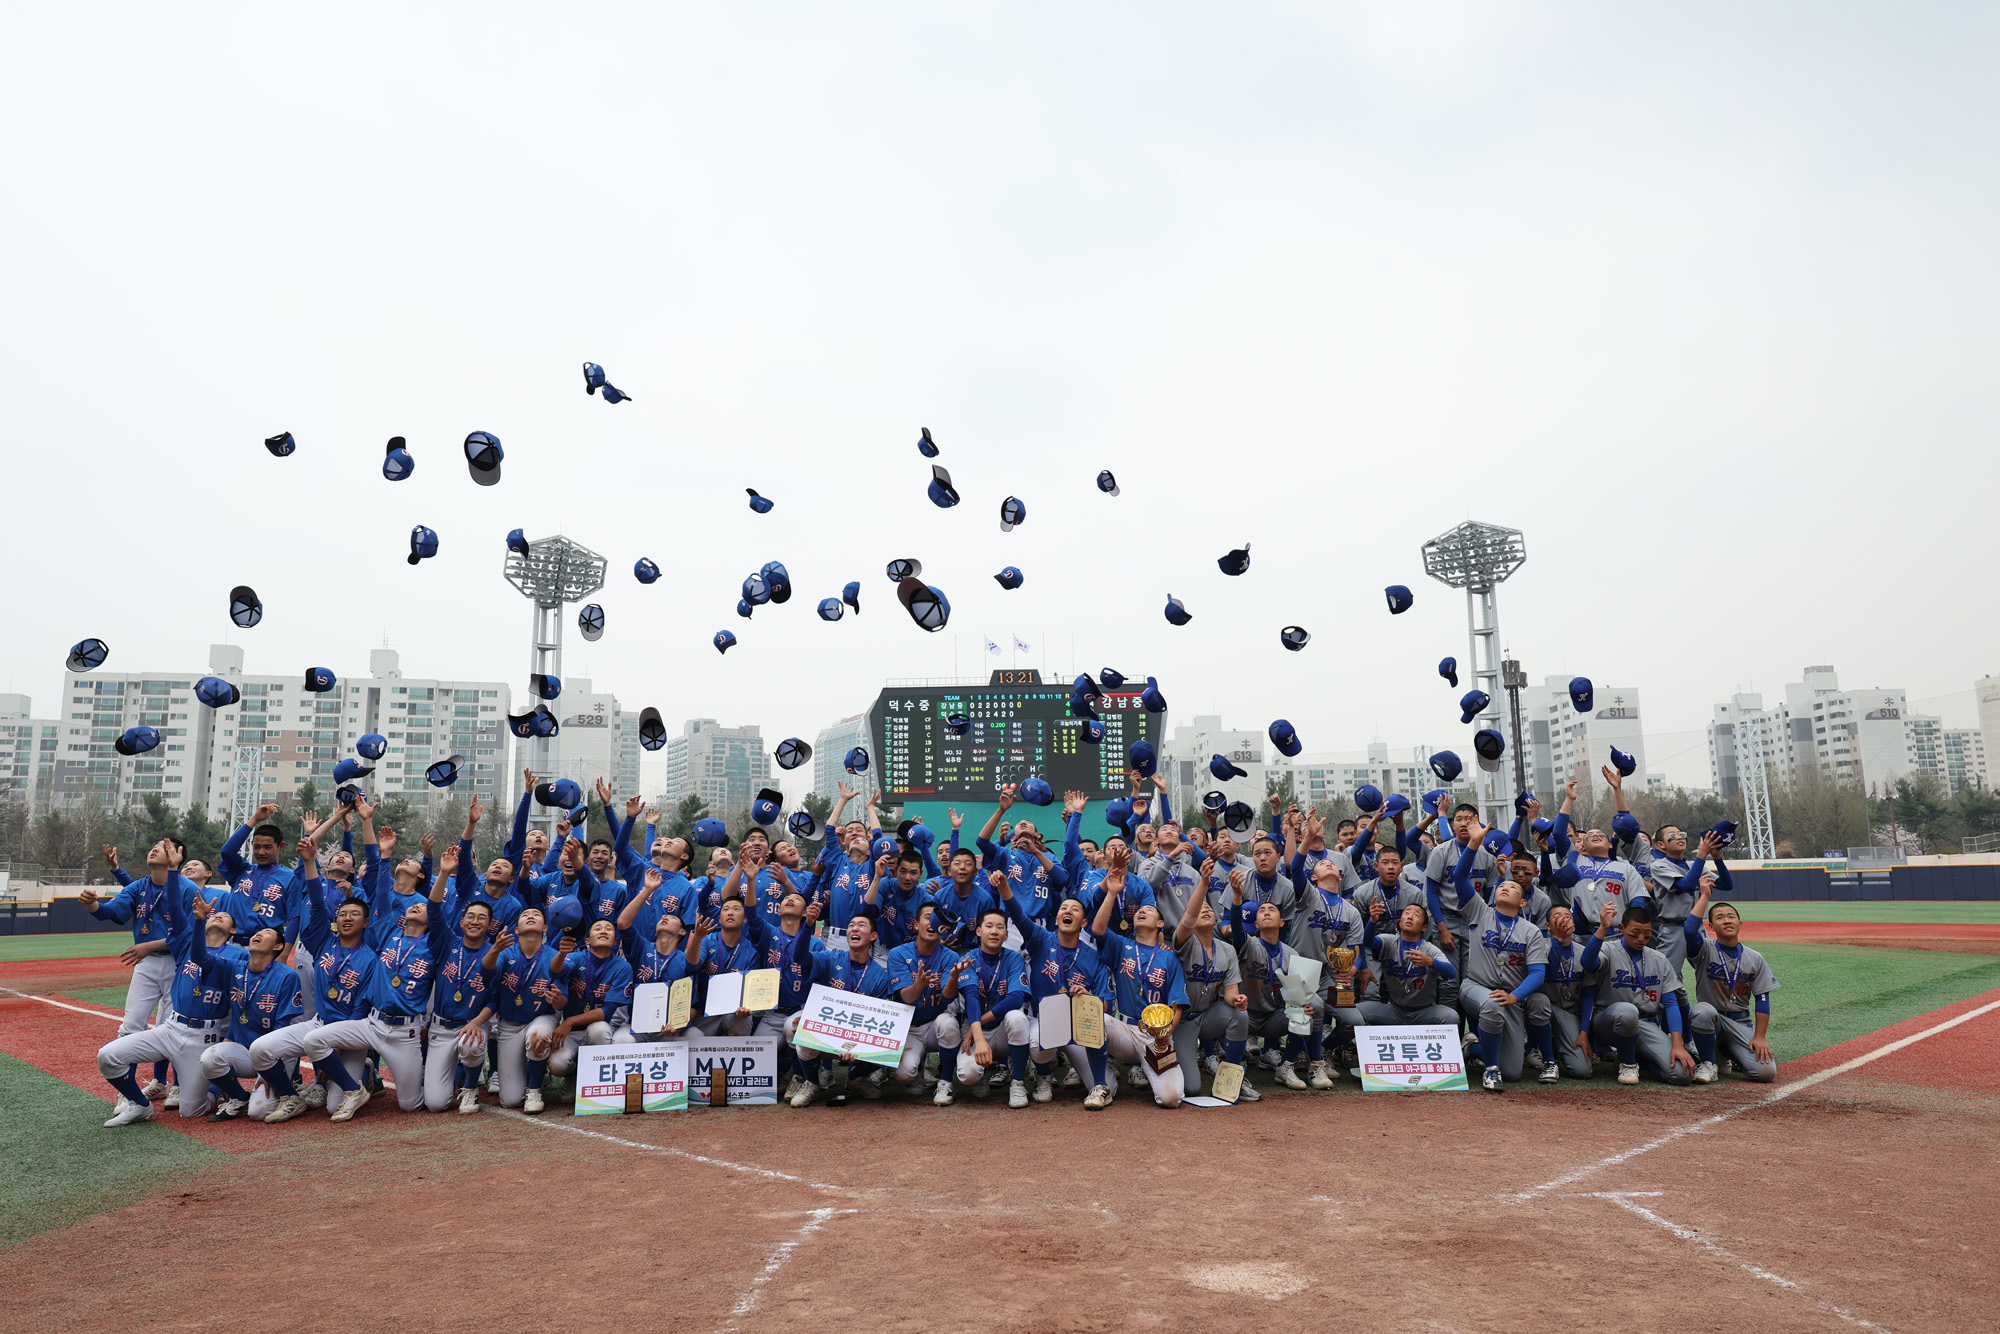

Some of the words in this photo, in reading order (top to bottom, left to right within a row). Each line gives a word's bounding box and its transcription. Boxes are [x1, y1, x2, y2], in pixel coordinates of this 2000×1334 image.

[717, 633, 728, 644] D
[1610, 707, 1625, 717] 511
[1880, 708, 1898, 718] 510
[578, 715, 603, 725] 529
[1234, 751, 1252, 761] 513
[880, 840, 891, 853] D
[1489, 840, 1499, 852] K
[1035, 885, 1048, 899] 50
[1474, 881, 1482, 892] 8
[1605, 882, 1622, 896] 38
[259, 903, 276, 918] 55
[1508, 955, 1525, 966] 22
[405, 980, 416, 994] 2
[793, 979, 801, 992] 8
[1413, 979, 1425, 990] 17
[203, 990, 223, 1004] 28
[336, 989, 352, 1005] 14
[468, 995, 476, 1008] 1
[1148, 990, 1161, 1003] 10
[533, 1000, 542, 1012] 7
[262, 1017, 270, 1028] 9
[818, 1006, 895, 1036] 우수투수상
[204, 1034, 217, 1044] 28
[409, 1029, 416, 1039] 2
[806, 1020, 844, 1036] 골드볼파크
[844, 1028, 874, 1043] 야구용품
[875, 1036, 898, 1049] 상품권
[1377, 1043, 1443, 1062] 감투상
[1367, 1064, 1404, 1073] 골드볼파크
[1406, 1064, 1434, 1073] 야구용품
[1436, 1063, 1458, 1072] 상품권
[747, 1077, 768, 1086] 글러브
[584, 1086, 623, 1096] 골드볼파크
